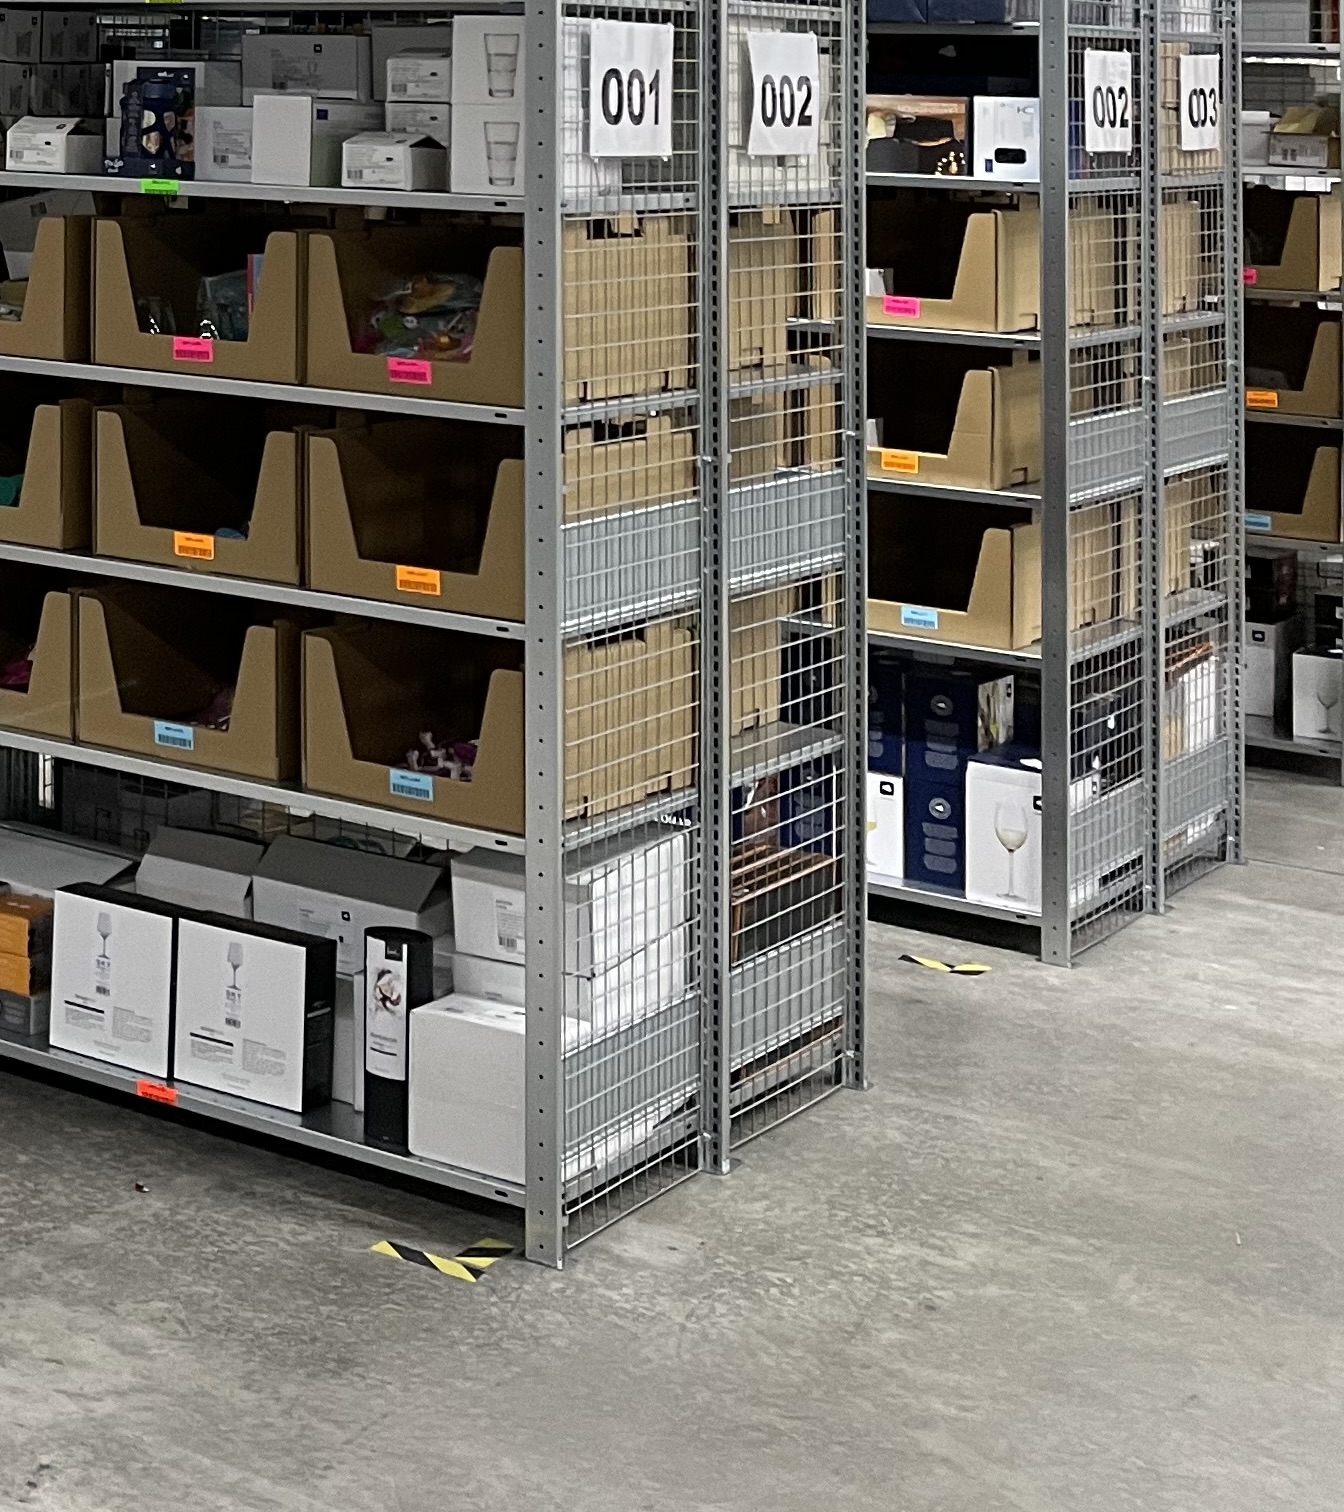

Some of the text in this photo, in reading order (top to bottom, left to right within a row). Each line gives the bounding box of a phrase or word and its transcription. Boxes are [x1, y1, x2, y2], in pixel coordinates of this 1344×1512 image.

[601, 67, 661, 127] 001
[761, 74, 813, 128] 002
[1092, 85, 1129, 129] 002
[1188, 87, 1218, 129] 003
